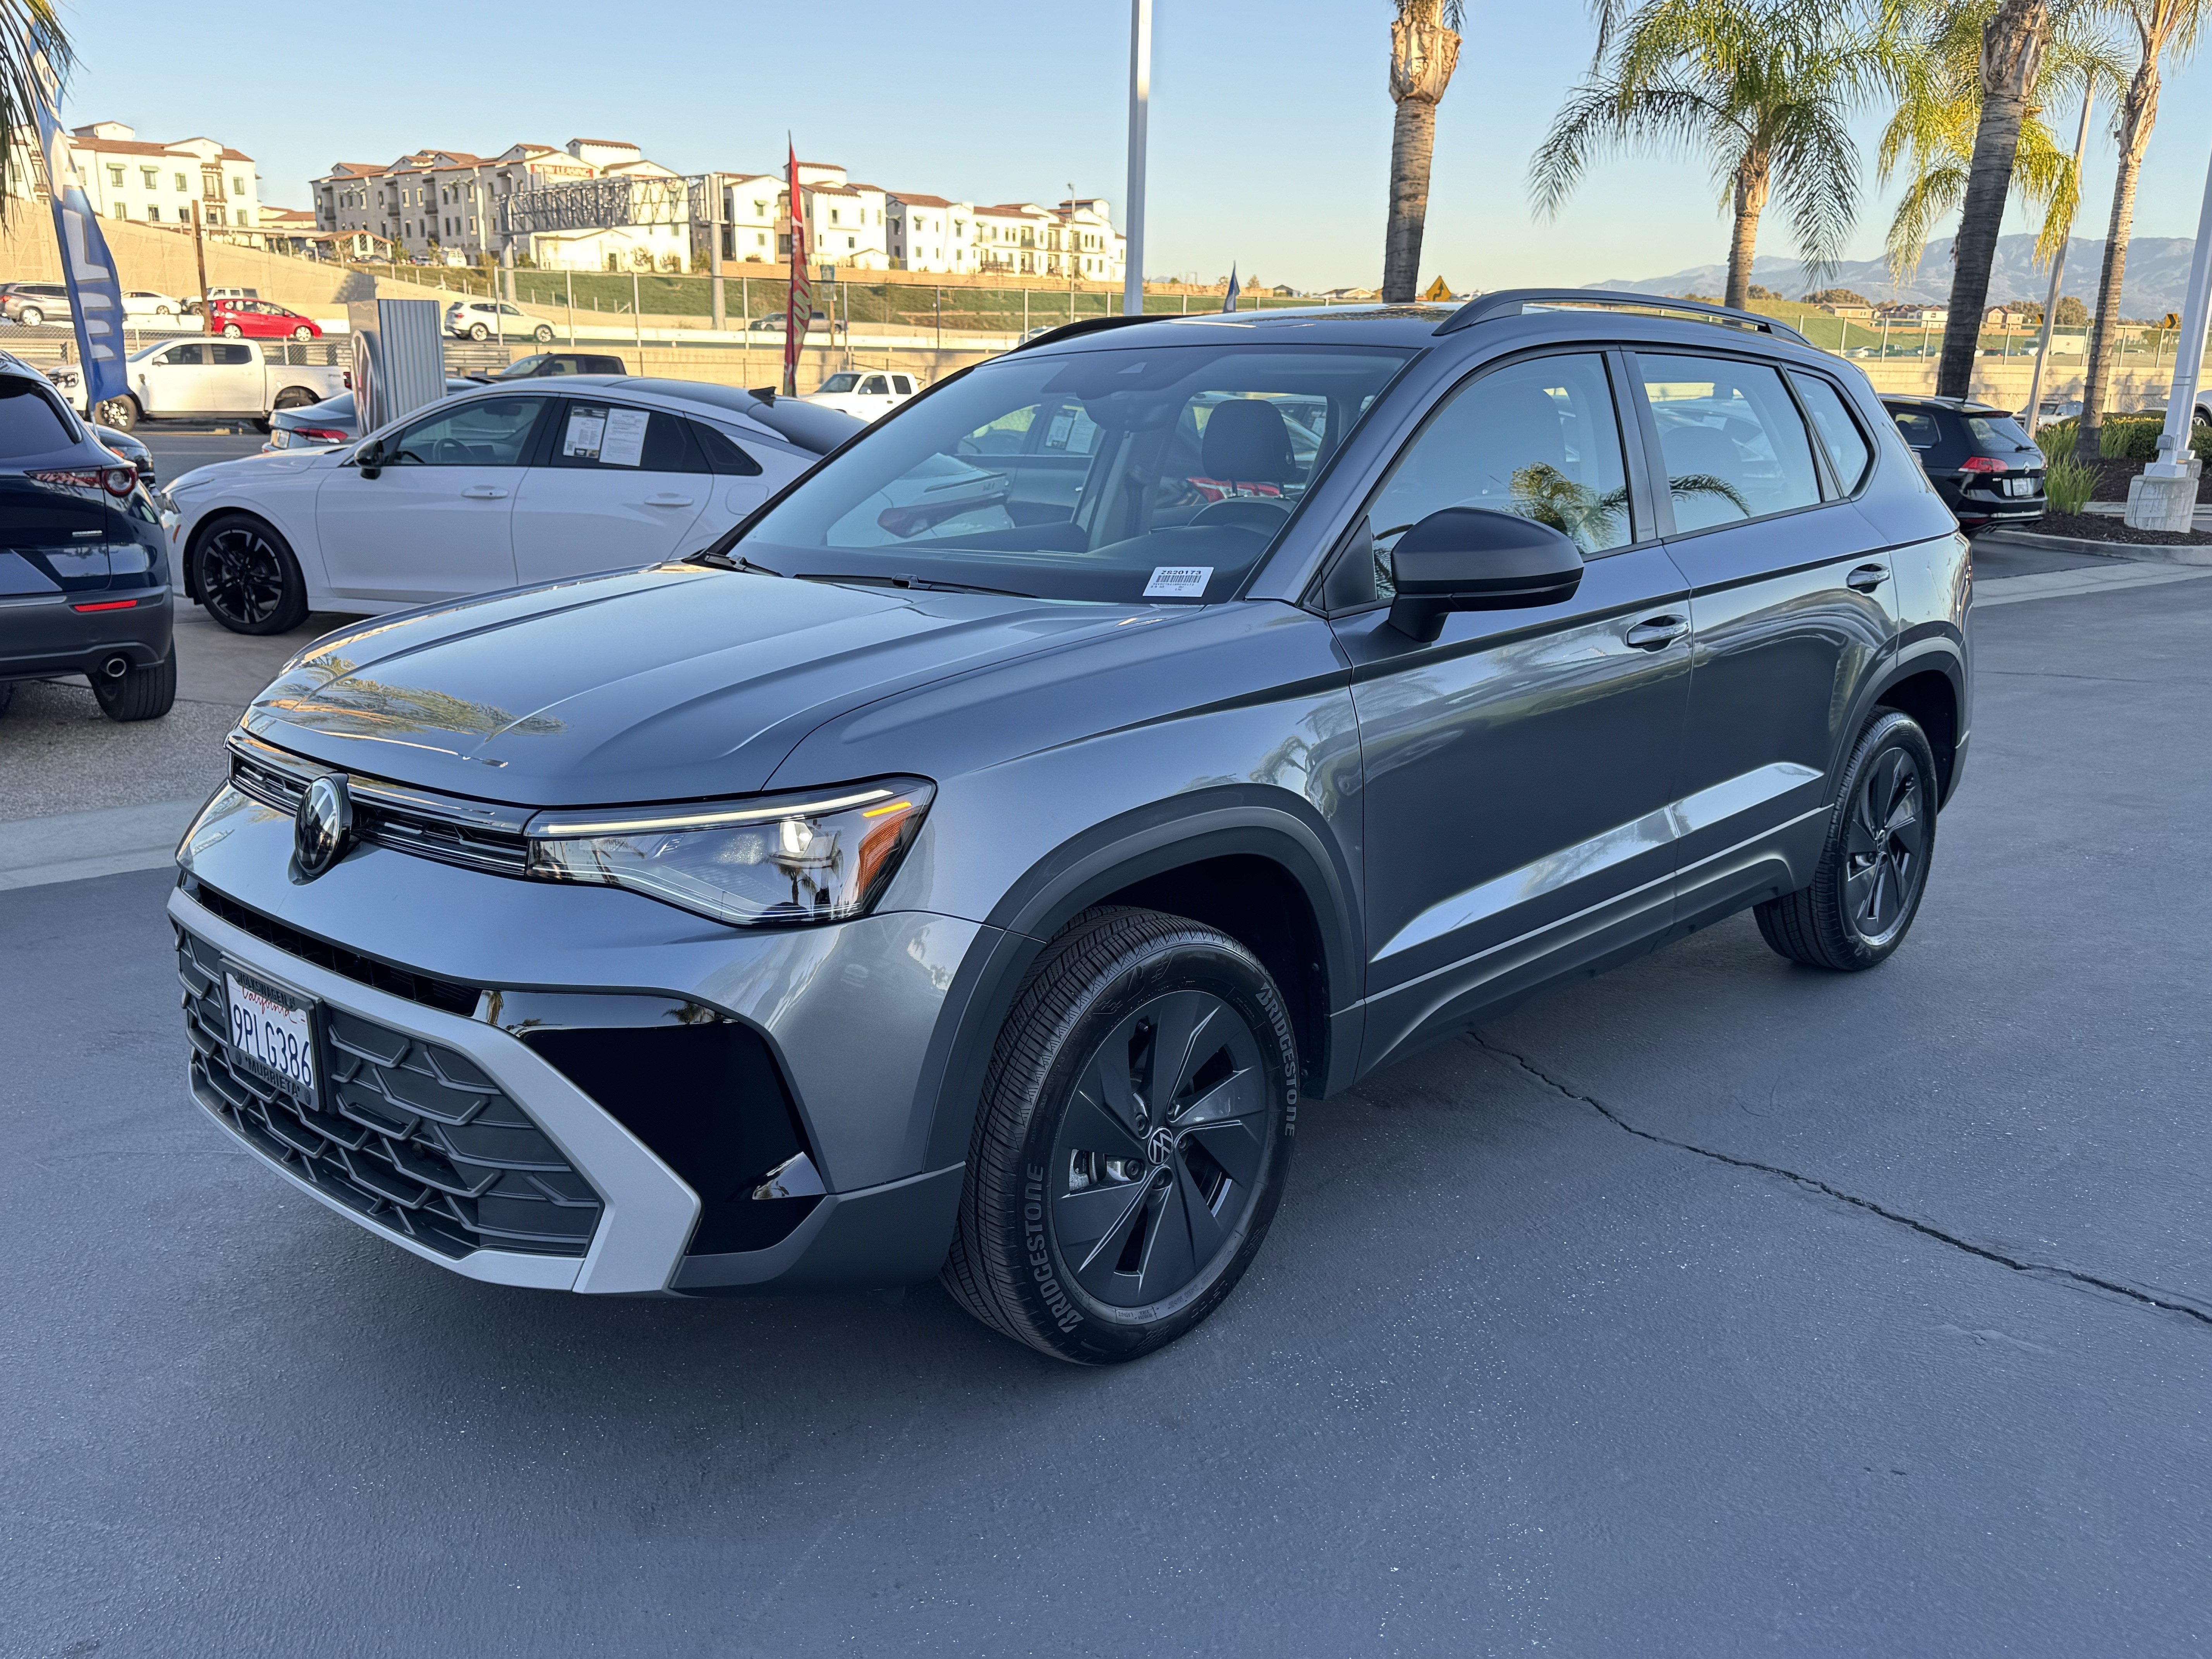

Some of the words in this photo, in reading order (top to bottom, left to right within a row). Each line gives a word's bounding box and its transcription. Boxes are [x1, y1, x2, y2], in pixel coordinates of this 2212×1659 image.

[556, 166, 590, 177] LEASING
[238, 972, 288, 1007] VOLKSWAGEN
[233, 1004, 312, 1087] 9PLG386
[1255, 982, 1297, 1137] BRIDGESTONE
[248, 1057, 299, 1097] MURRIETA
[1024, 1163, 1084, 1333] BRIDGESTONE
